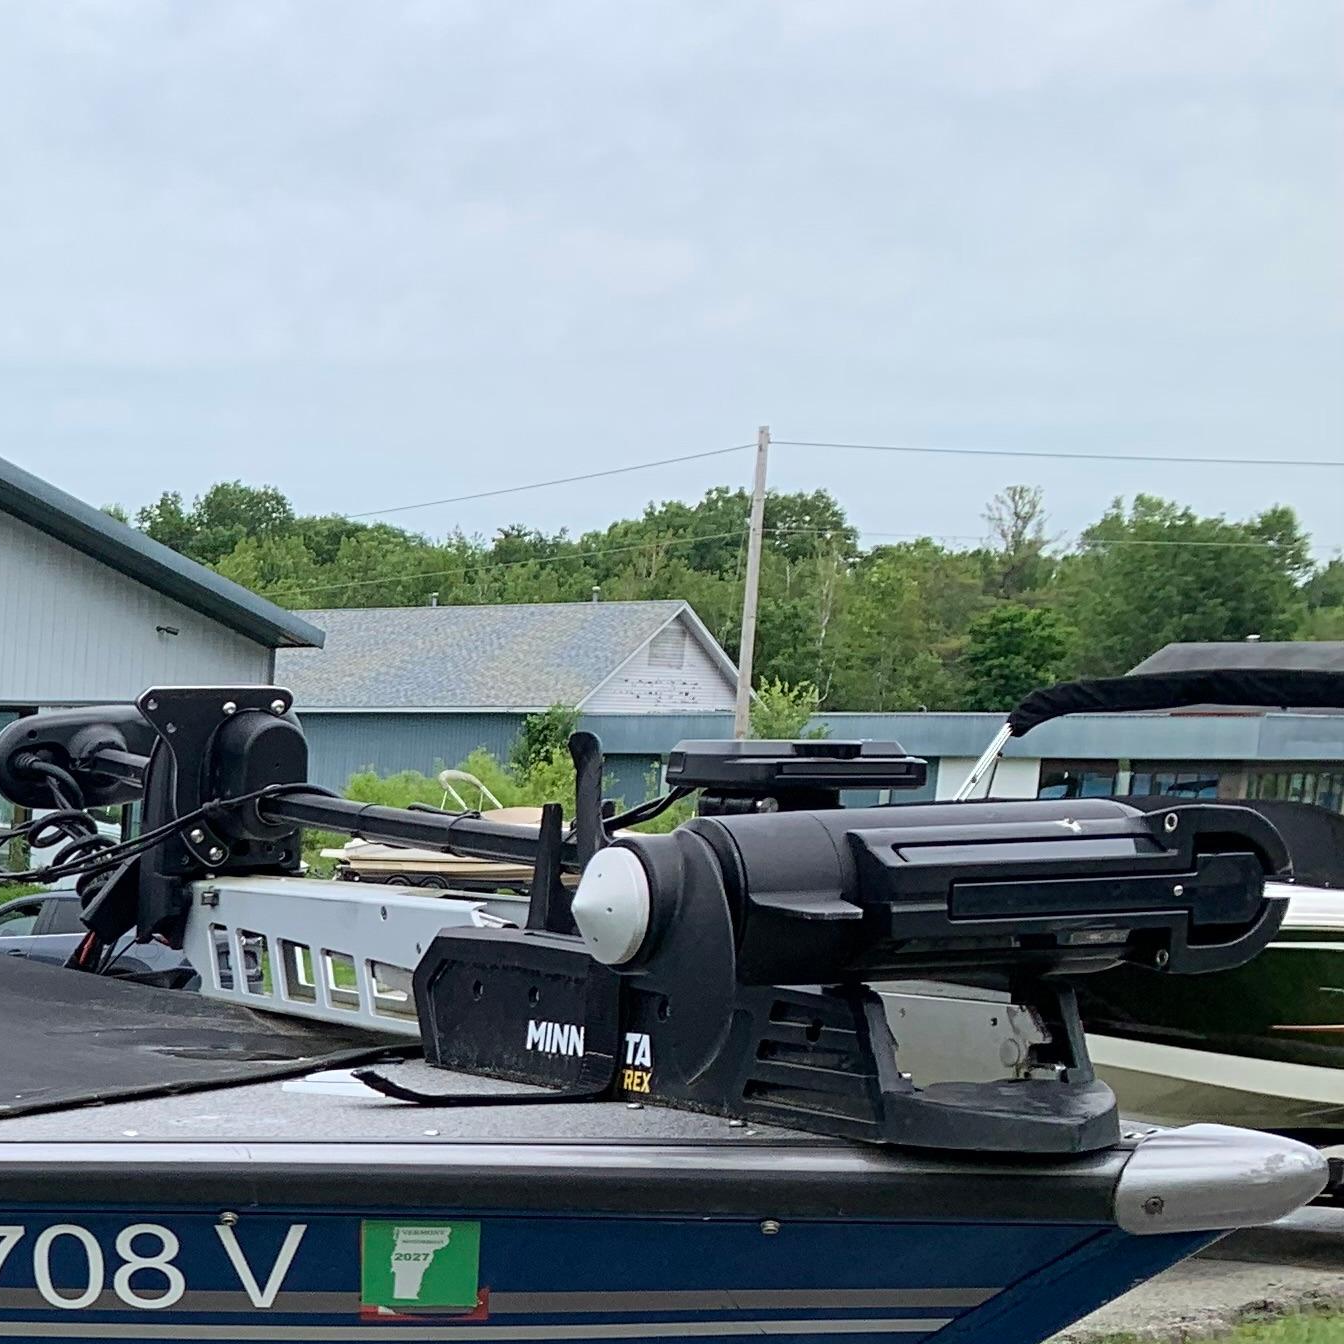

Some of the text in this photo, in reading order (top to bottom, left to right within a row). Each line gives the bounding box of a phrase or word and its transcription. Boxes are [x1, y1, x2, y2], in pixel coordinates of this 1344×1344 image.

[526, 1019, 585, 1057] MINN
[214, 1223, 308, 1309] V
[394, 1252, 431, 1262] 2027
